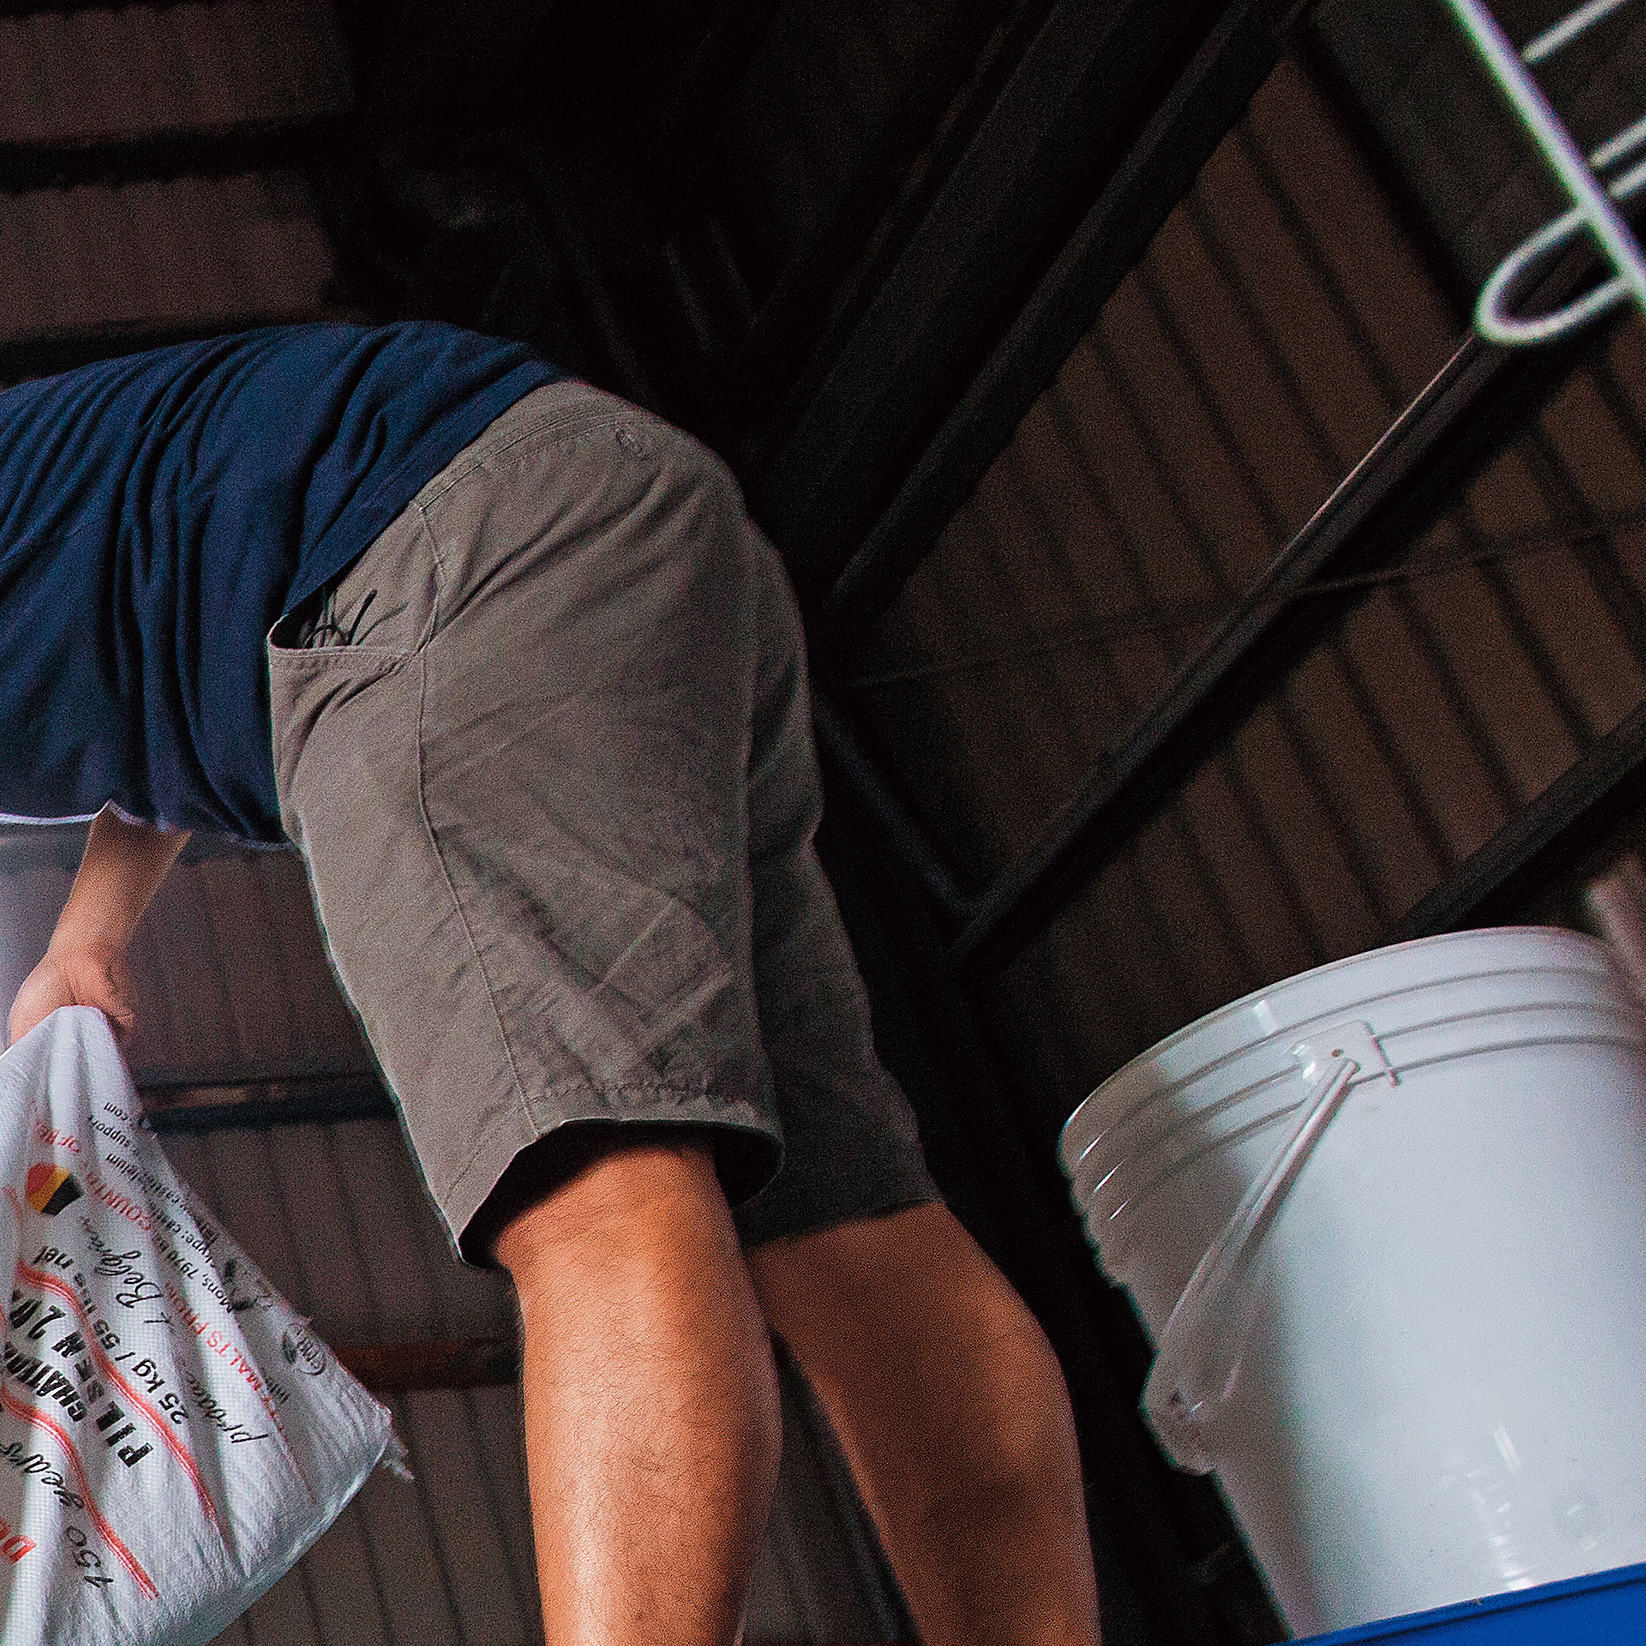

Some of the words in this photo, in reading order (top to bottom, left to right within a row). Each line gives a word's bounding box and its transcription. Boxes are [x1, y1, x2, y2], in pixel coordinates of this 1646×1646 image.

[93, 1318, 120, 1350] 55
[131, 1357, 165, 1394] kg
[206, 1329, 263, 1392] MALTS
[51, 1331, 153, 1467] PILSEN
[158, 1392, 189, 1425] 25
[65, 1525, 114, 1589] 150
